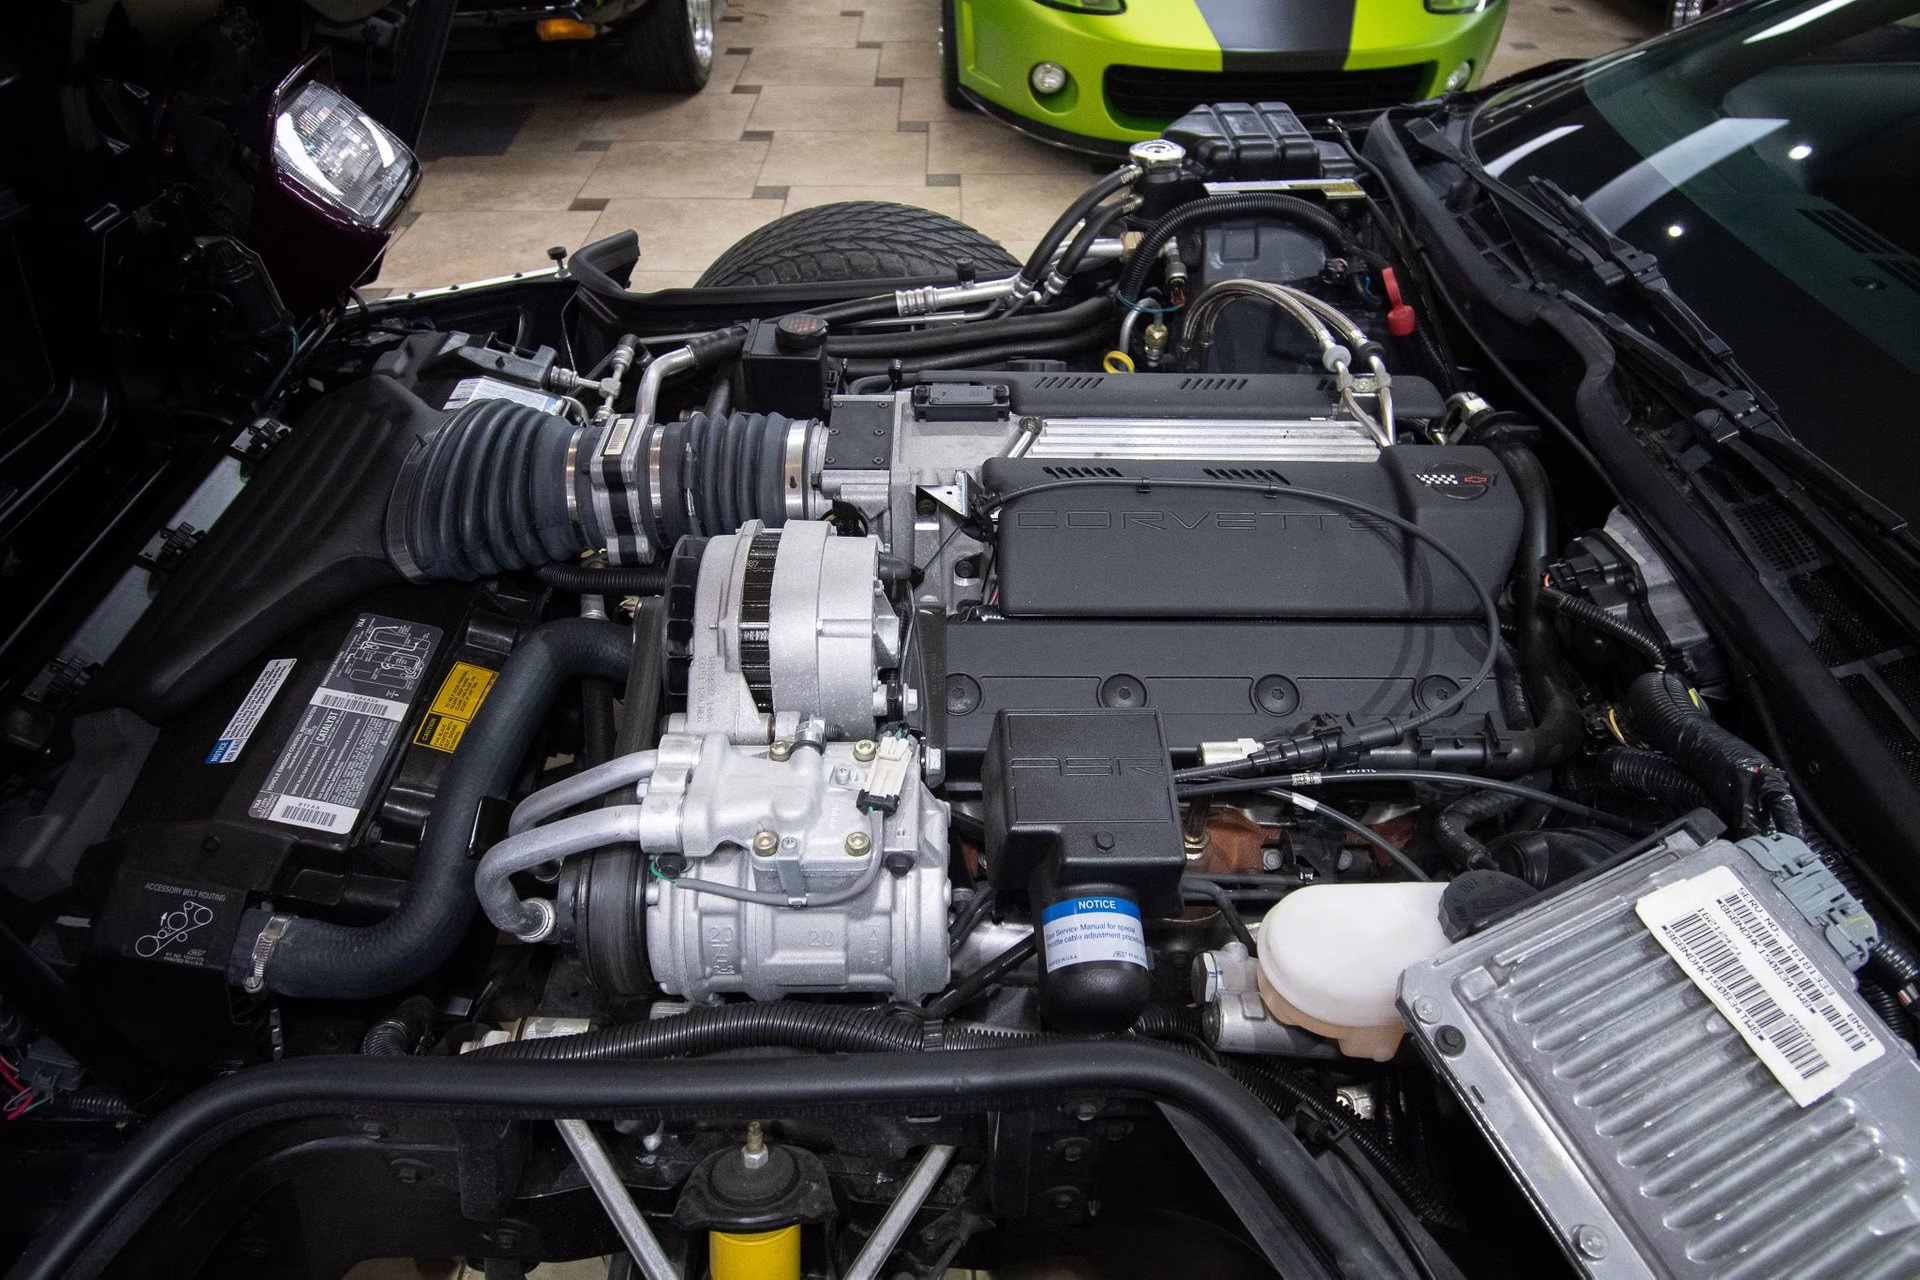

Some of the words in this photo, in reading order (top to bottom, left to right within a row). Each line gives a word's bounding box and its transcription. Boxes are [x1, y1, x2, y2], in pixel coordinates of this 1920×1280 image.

[1014, 511, 1388, 531] CORVETTE
[355, 617, 366, 627] YAA
[314, 710, 339, 741] CATALYST
[420, 716, 438, 740] CAUTION
[209, 742, 228, 761] NOTICE
[144, 882, 182, 895] ACCESSORY
[182, 888, 197, 897] BELT
[197, 890, 225, 901] ROUTING
[1078, 900, 1116, 909] NOTICE
[708, 926, 735, 943] 20
[808, 930, 835, 947] 20
[1055, 927, 1078, 937] Service
[1080, 922, 1105, 931] Manual
[1117, 924, 1136, 934] special
[1064, 934, 1083, 943] cable
[1083, 931, 1121, 941] adjustment
[1787, 944, 1835, 997] 16181333
[1847, 1013, 1875, 1042] BNDH
